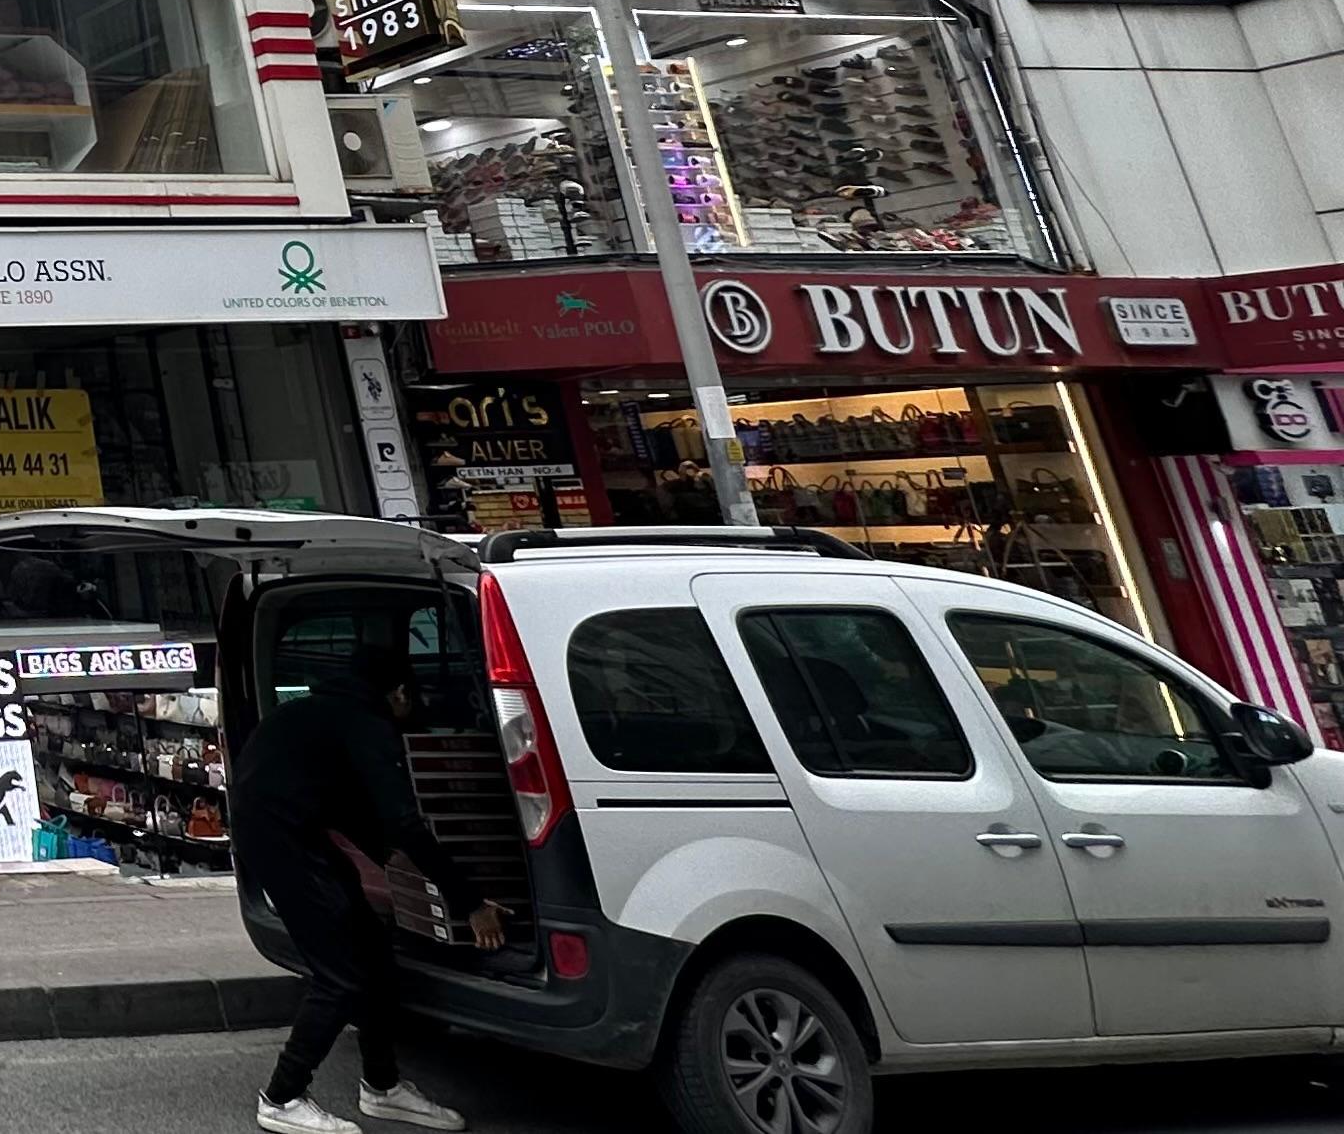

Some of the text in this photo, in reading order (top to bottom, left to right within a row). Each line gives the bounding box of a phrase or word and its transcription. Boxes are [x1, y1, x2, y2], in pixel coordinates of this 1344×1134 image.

[342, 3, 421, 52] 1983
[34, 260, 112, 281] ASSN.
[17, 290, 53, 304] 1890
[223, 298, 264, 309] UNITED
[266, 297, 310, 308] COLORS
[312, 297, 327, 307] OF
[801, 284, 1082, 355] BUTUN
[1115, 304, 1184, 319] SINCE
[532, 320, 634, 339] Valen POLO
[471, 440, 547, 462] ALVER
[23, 453, 43, 475] 44
[49, 453, 69, 475] 31
[498, 467, 523, 476] HAN
[28, 652, 83, 674] BAGS
[139, 648, 194, 671] BAGS
